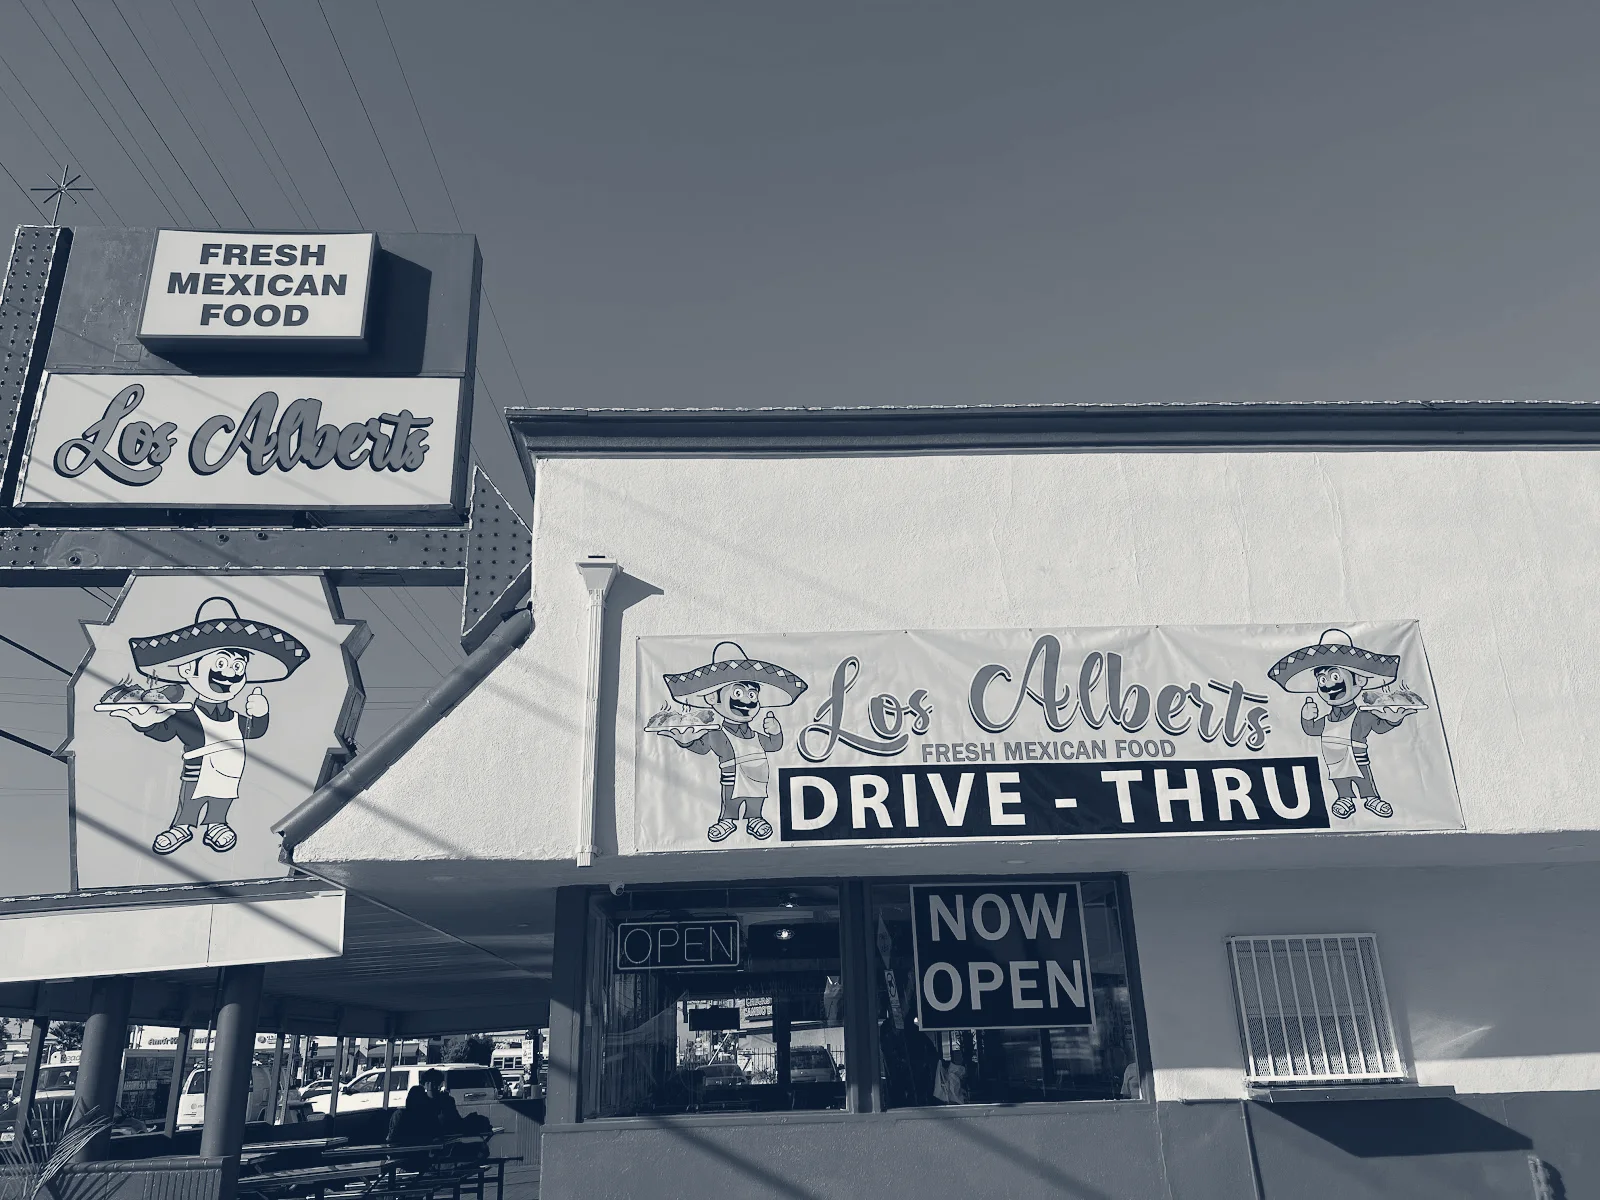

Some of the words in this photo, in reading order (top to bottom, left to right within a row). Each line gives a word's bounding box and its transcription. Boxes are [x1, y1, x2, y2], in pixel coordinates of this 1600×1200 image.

[199, 243, 327, 266] FRESH
[167, 272, 348, 296] MEXICAN
[199, 304, 310, 327] FOOD
[54, 383, 178, 487] Los
[188, 390, 434, 476] Alberts
[797, 655, 933, 762] Los
[968, 633, 1272, 752] Alberts
[921, 742, 997, 765] FRESH
[1003, 739, 1107, 762] MEXICAN
[1115, 737, 1177, 759] FOOD
[789, 771, 1028, 832] DRIVE
[1101, 765, 1313, 824] THRU
[929, 893, 1068, 942] NOW
[623, 926, 734, 965] OPEN
[922, 959, 1086, 1012] OPEN
